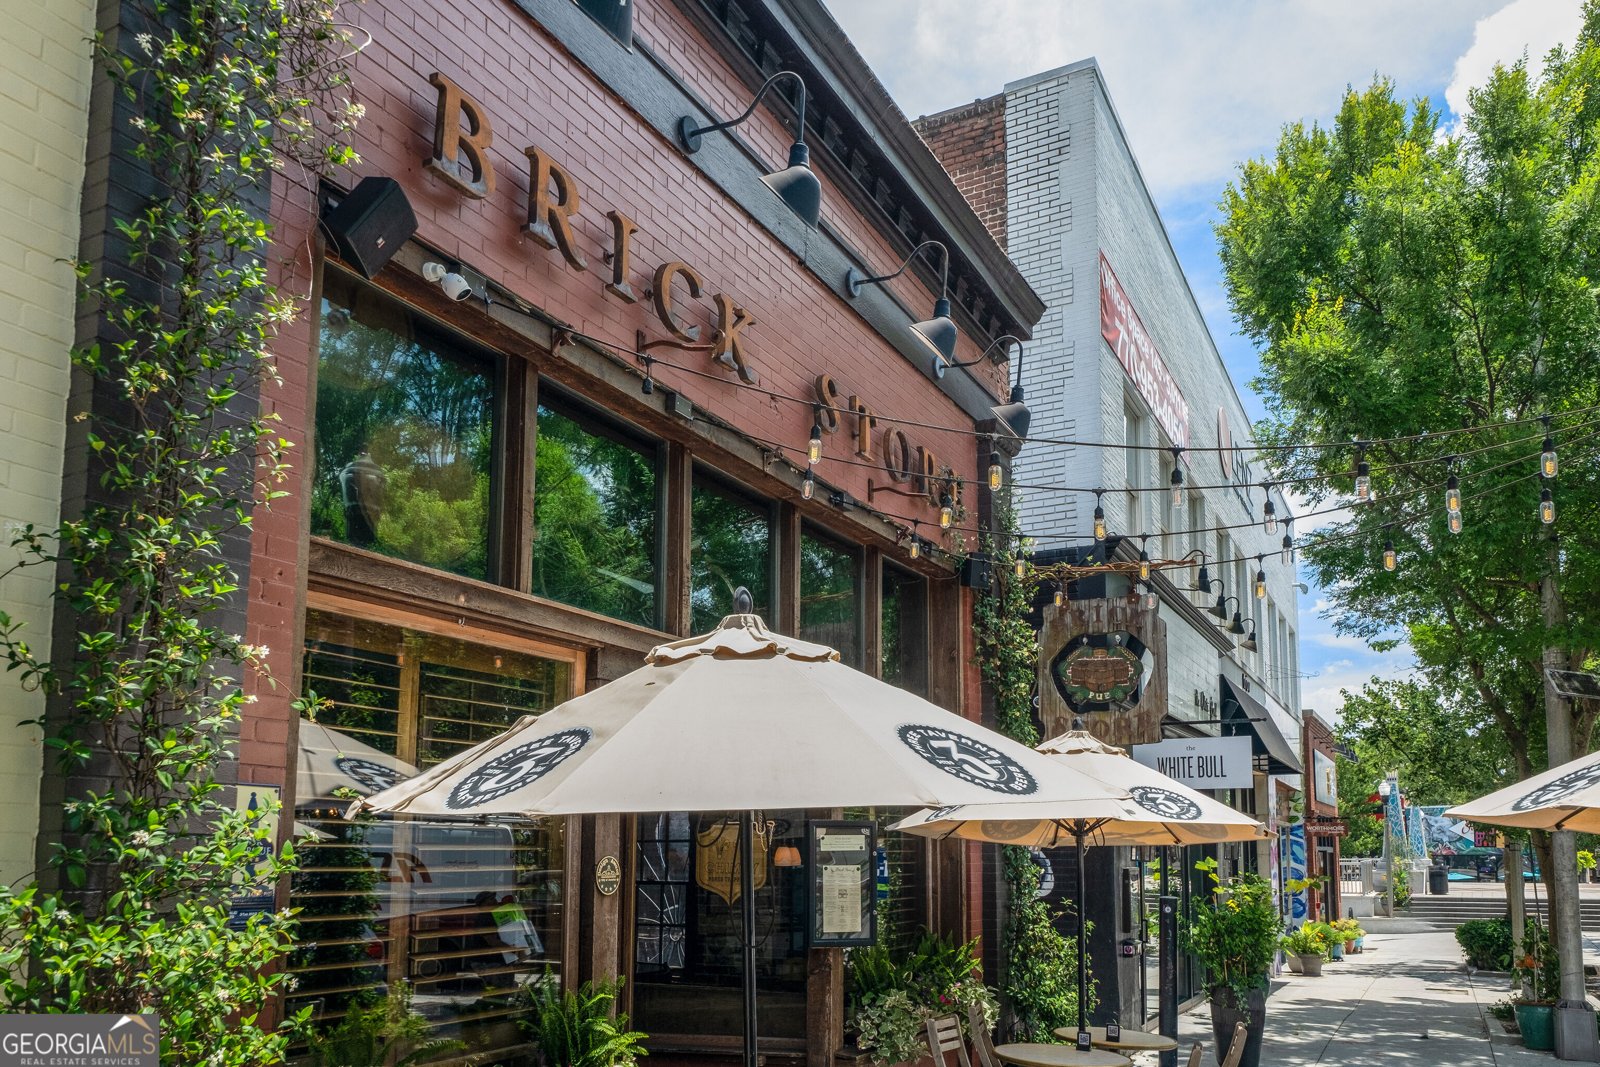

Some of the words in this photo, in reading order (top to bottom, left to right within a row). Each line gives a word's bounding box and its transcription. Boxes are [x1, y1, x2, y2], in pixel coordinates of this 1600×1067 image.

[422, 72, 757, 385] BRICK
[1101, 259, 1126, 320] Office
[1127, 305, 1149, 360] Space
[815, 373, 963, 509] STORE
[916, 728, 1001, 758] TAVERNS
[1157, 756, 1194, 779] WHITE
[1197, 755, 1227, 779] BULL
